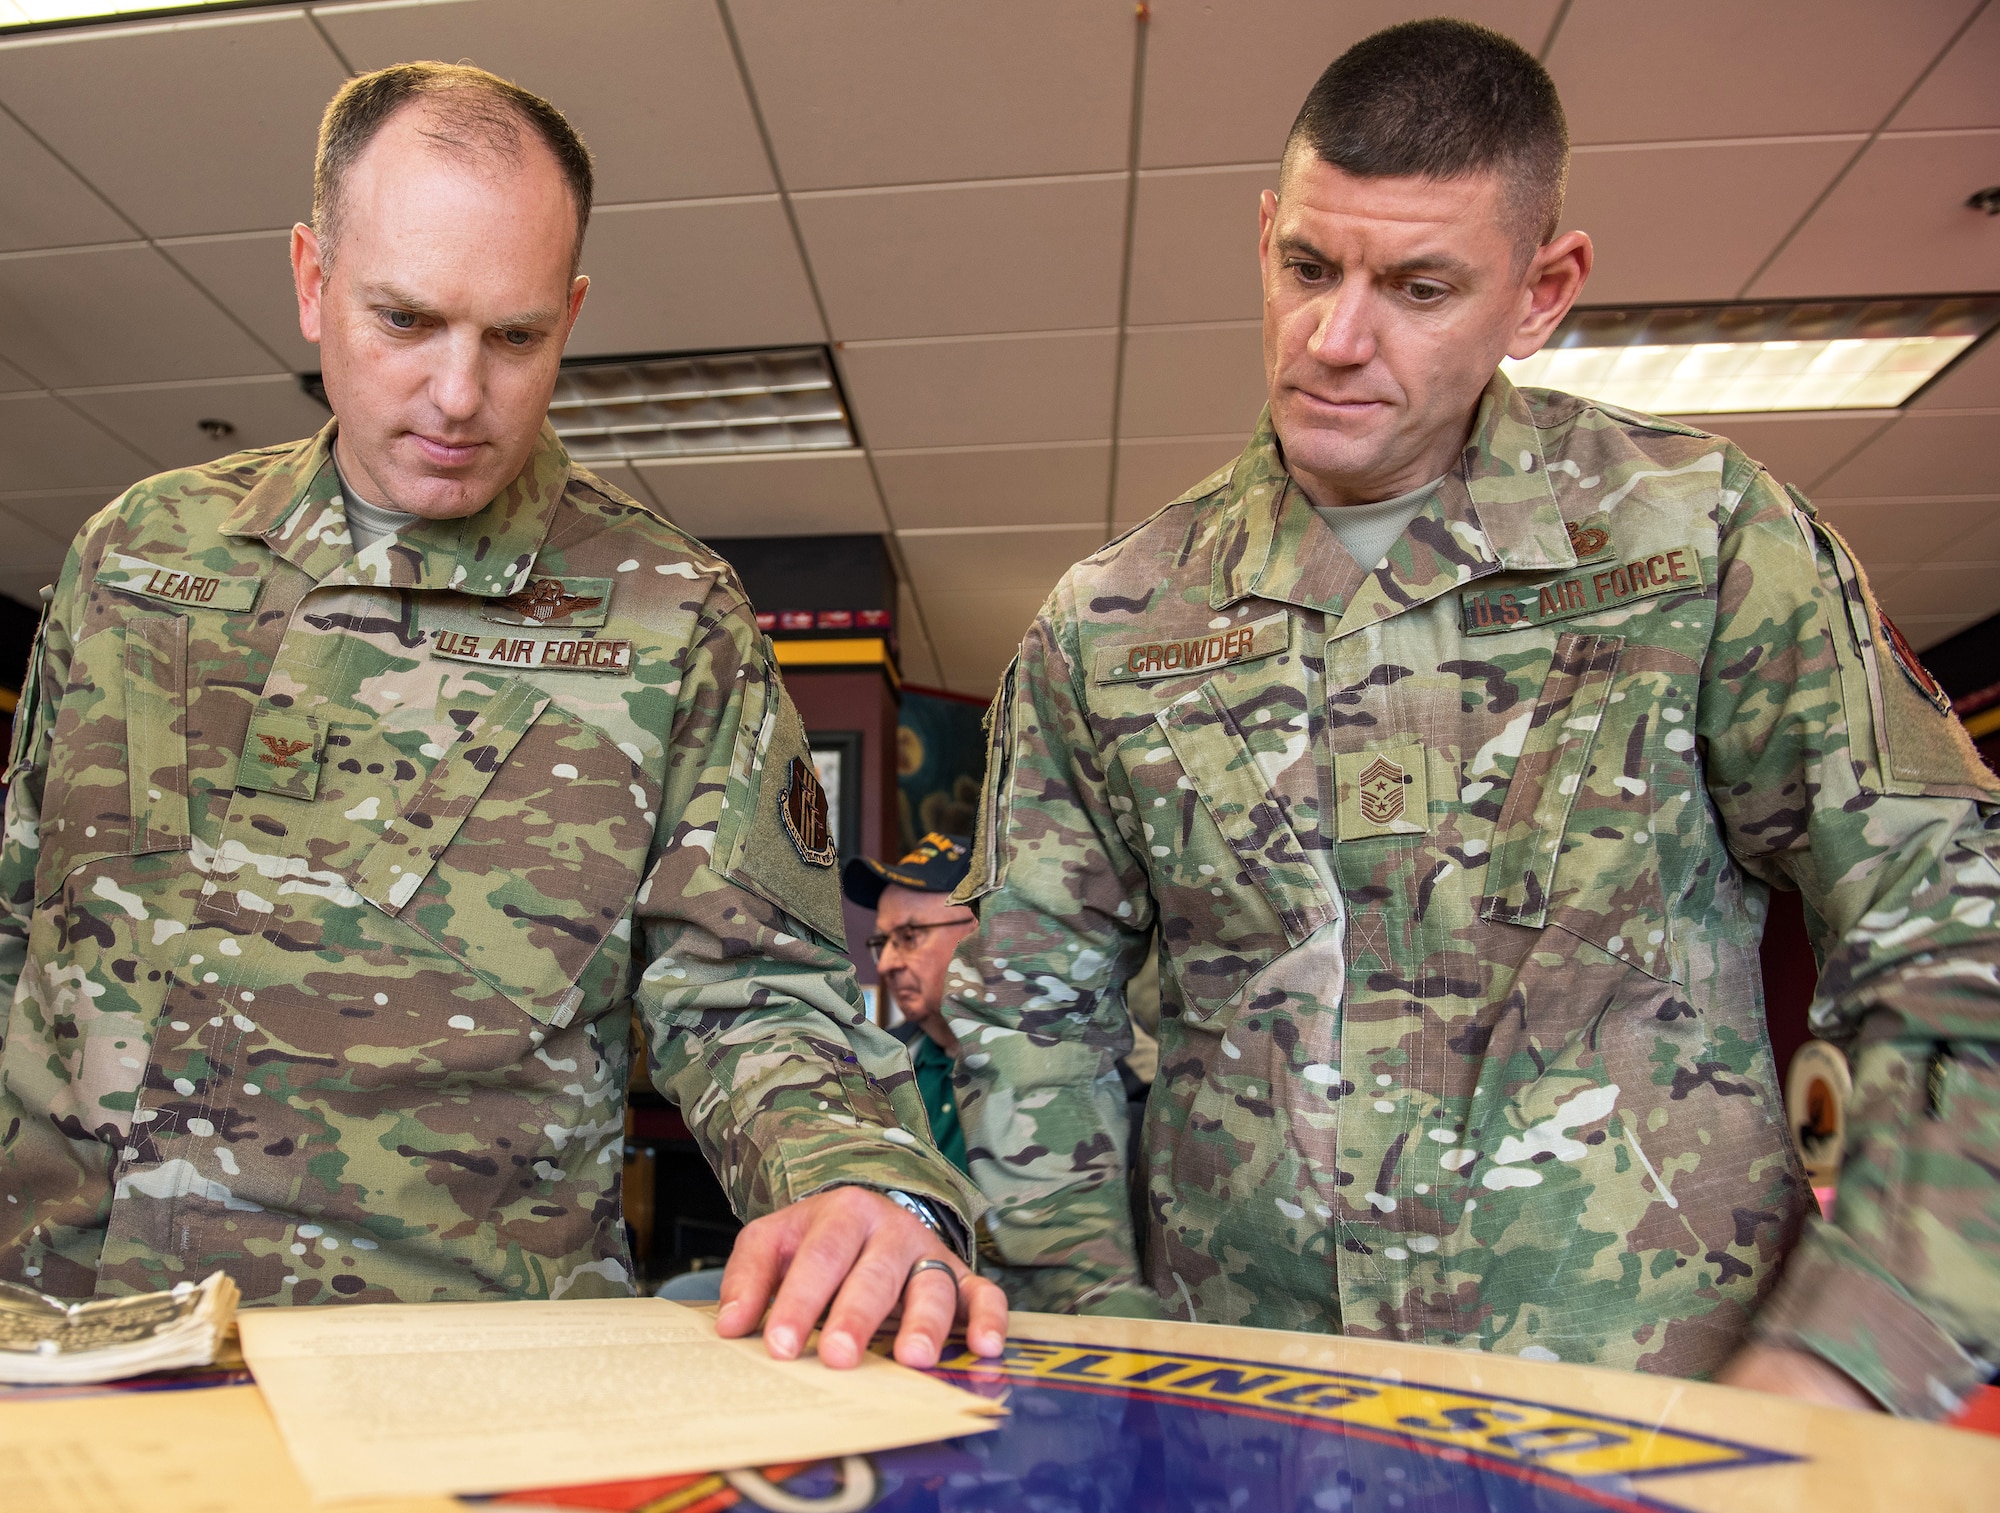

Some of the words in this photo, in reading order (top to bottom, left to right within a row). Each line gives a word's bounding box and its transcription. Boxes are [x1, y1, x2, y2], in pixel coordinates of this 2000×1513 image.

[146, 569, 220, 602] LEARD
[1473, 594, 1528, 627] U.S.
[1539, 579, 1586, 617] AIR
[1593, 550, 1688, 603] FORCE
[435, 630, 480, 658] U.S.
[488, 639, 535, 663] AIR
[541, 641, 627, 667] FORCE
[1128, 626, 1254, 673] CROWDER
